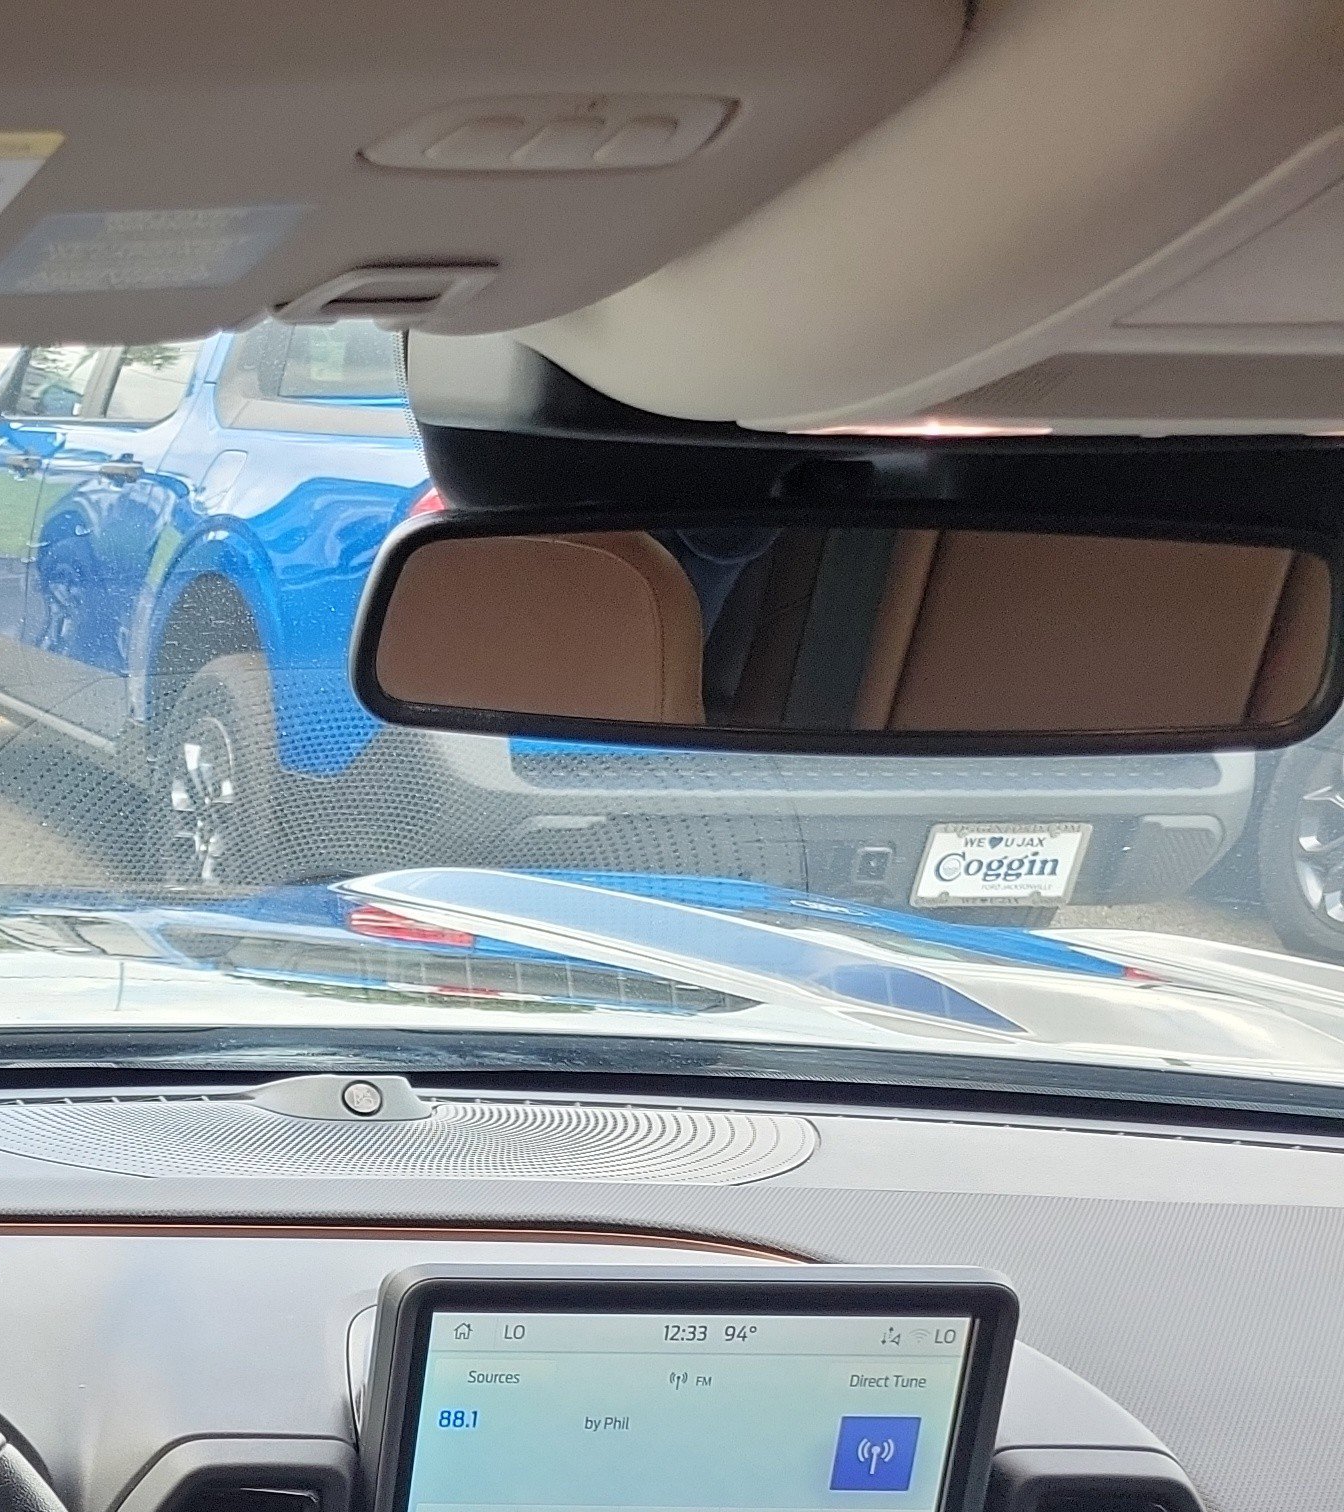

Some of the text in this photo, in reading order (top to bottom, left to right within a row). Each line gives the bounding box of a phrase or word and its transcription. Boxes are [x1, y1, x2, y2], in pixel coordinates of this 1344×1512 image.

[964, 837, 1047, 848] WE U JAX
[935, 851, 1059, 882] Coggin
[503, 1324, 526, 1340] LO
[663, 1324, 758, 1342] 12:33 94°
[934, 1328, 957, 1344] LO
[467, 1370, 520, 1384] Sources
[695, 1375, 712, 1387] FM
[849, 1374, 927, 1388] Direct Tune
[438, 1409, 478, 1428] 88.1
[583, 1416, 630, 1432] by Phil
